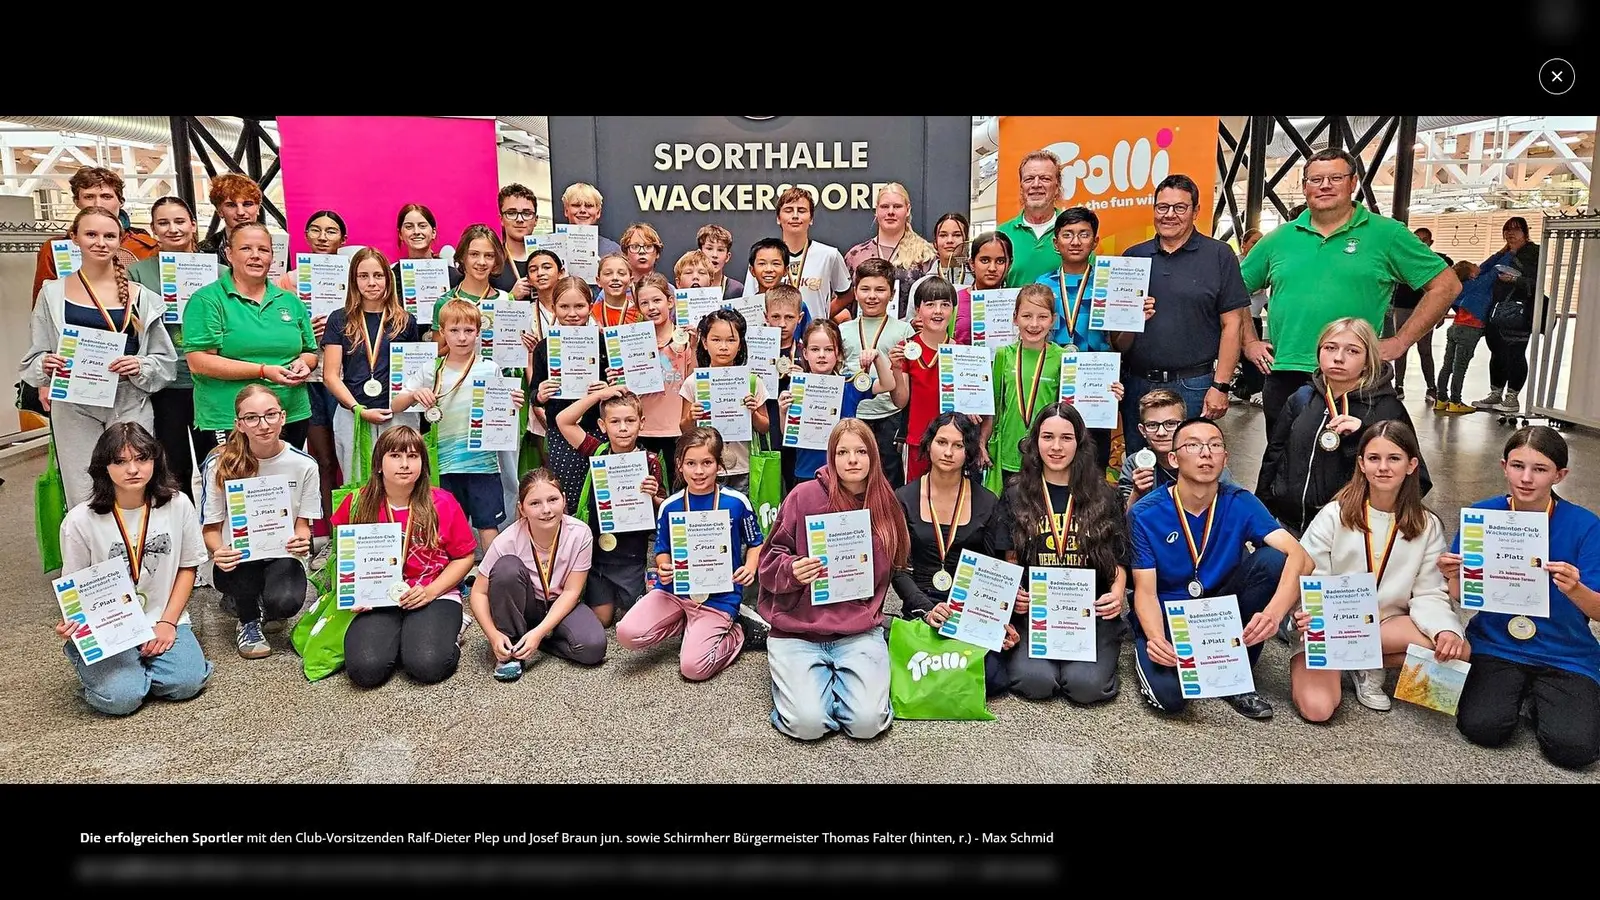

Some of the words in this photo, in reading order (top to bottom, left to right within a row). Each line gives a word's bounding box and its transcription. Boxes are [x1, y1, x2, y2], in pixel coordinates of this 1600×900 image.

[653, 141, 869, 172] SPORTHALLE
[1110, 197, 1134, 208] fun
[1136, 194, 1154, 206] wi
[973, 294, 986, 347] RKUNDE
[1091, 260, 1111, 327] URKUNDE
[696, 372, 711, 427] RKUNDE
[940, 348, 954, 413] URKUNDE
[1062, 357, 1077, 404] KUNDE
[470, 380, 486, 448] URKUNDE
[785, 376, 806, 444] URKUNDE
[593, 460, 615, 531] URKUNDE
[672, 517, 690, 592] URKUNDE
[829, 530, 864, 538] Badminton-Club
[1486, 530, 1526, 538] Wackersdorf
[1488, 525, 1539, 533] Badminton-Club
[79, 570, 120, 589] Badminton-Club
[79, 579, 110, 594] Wackersdorf
[340, 529, 356, 607] URKUNDE
[1464, 514, 1485, 608] URKUNDE
[1032, 572, 1047, 656] URKUNDE
[1190, 611, 1232, 619] Badminton-Club
[1304, 581, 1327, 667] URKUNDE
[907, 649, 973, 682] Trolli
[1168, 606, 1201, 695] URKUNDE
